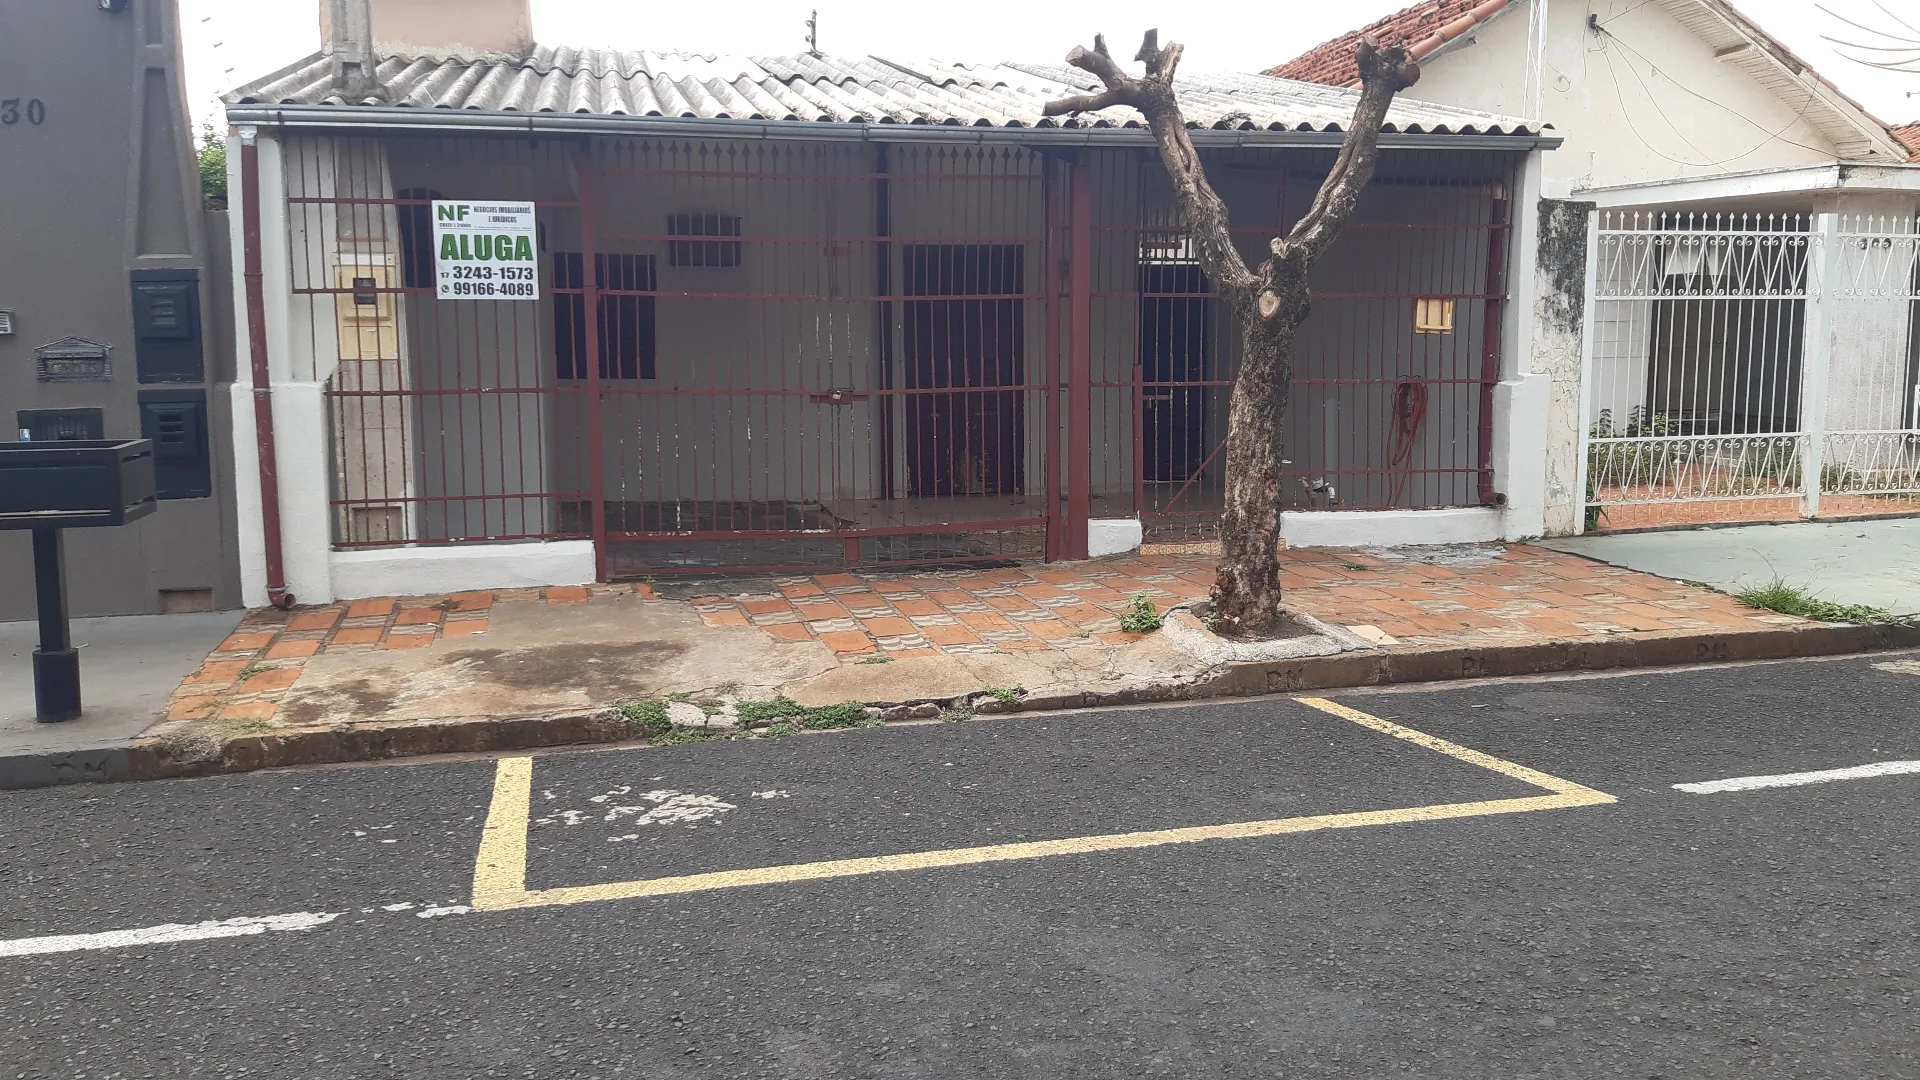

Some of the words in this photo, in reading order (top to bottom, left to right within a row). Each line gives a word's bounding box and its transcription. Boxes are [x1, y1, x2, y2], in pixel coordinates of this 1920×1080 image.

[1, 97, 45, 125] 30
[438, 204, 470, 221] NF
[440, 234, 534, 261] ALUGA
[453, 266, 534, 280] 3243-1573
[453, 282, 534, 296] 99166-4089
